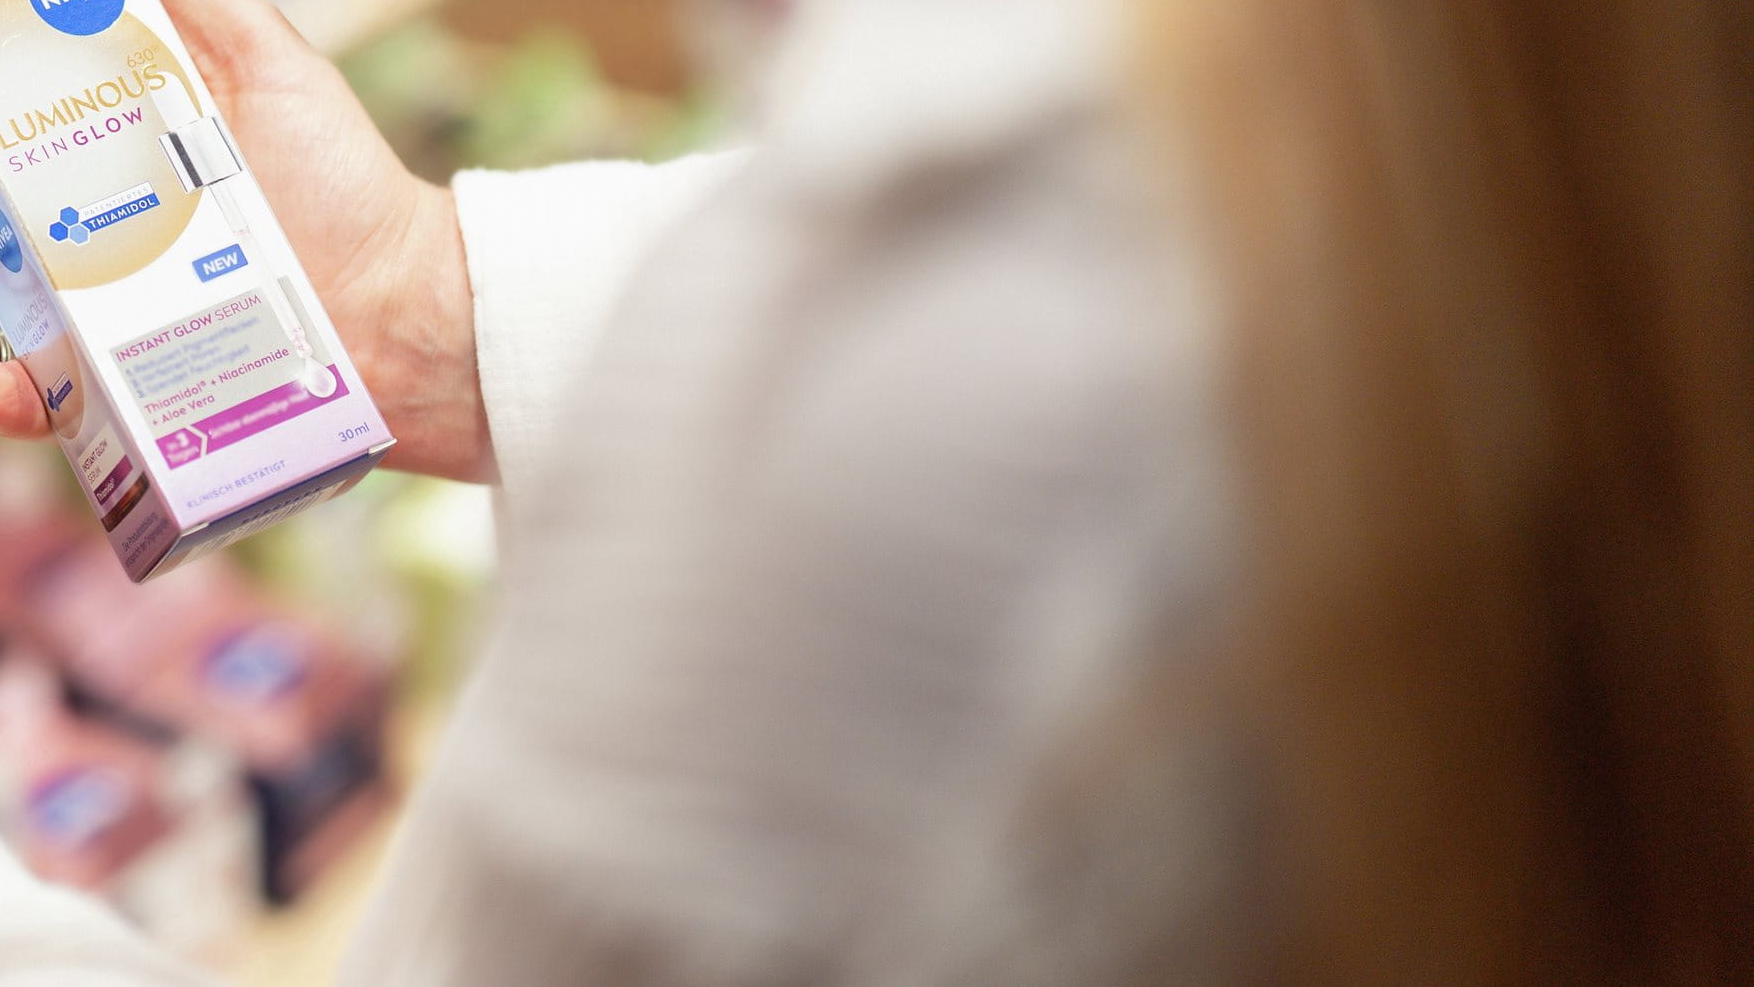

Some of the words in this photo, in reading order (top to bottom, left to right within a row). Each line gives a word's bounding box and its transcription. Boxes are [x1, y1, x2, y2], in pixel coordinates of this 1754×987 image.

[84, 186, 150, 216] PATENTIERTES
[88, 197, 155, 229] THIAMIDOL
[202, 252, 239, 276] NEW
[13, 292, 49, 344] LUMINOUS
[116, 331, 172, 363] INSTANT
[173, 313, 214, 339] GLOW
[214, 294, 262, 321] SERUM
[217, 347, 291, 383] Niacinamide
[160, 405, 187, 425] Aloe
[187, 394, 216, 414] Vera
[338, 421, 371, 444] 30ml
[186, 484, 234, 510] KLINISCH
[233, 460, 286, 490] BESTÄTIGT
